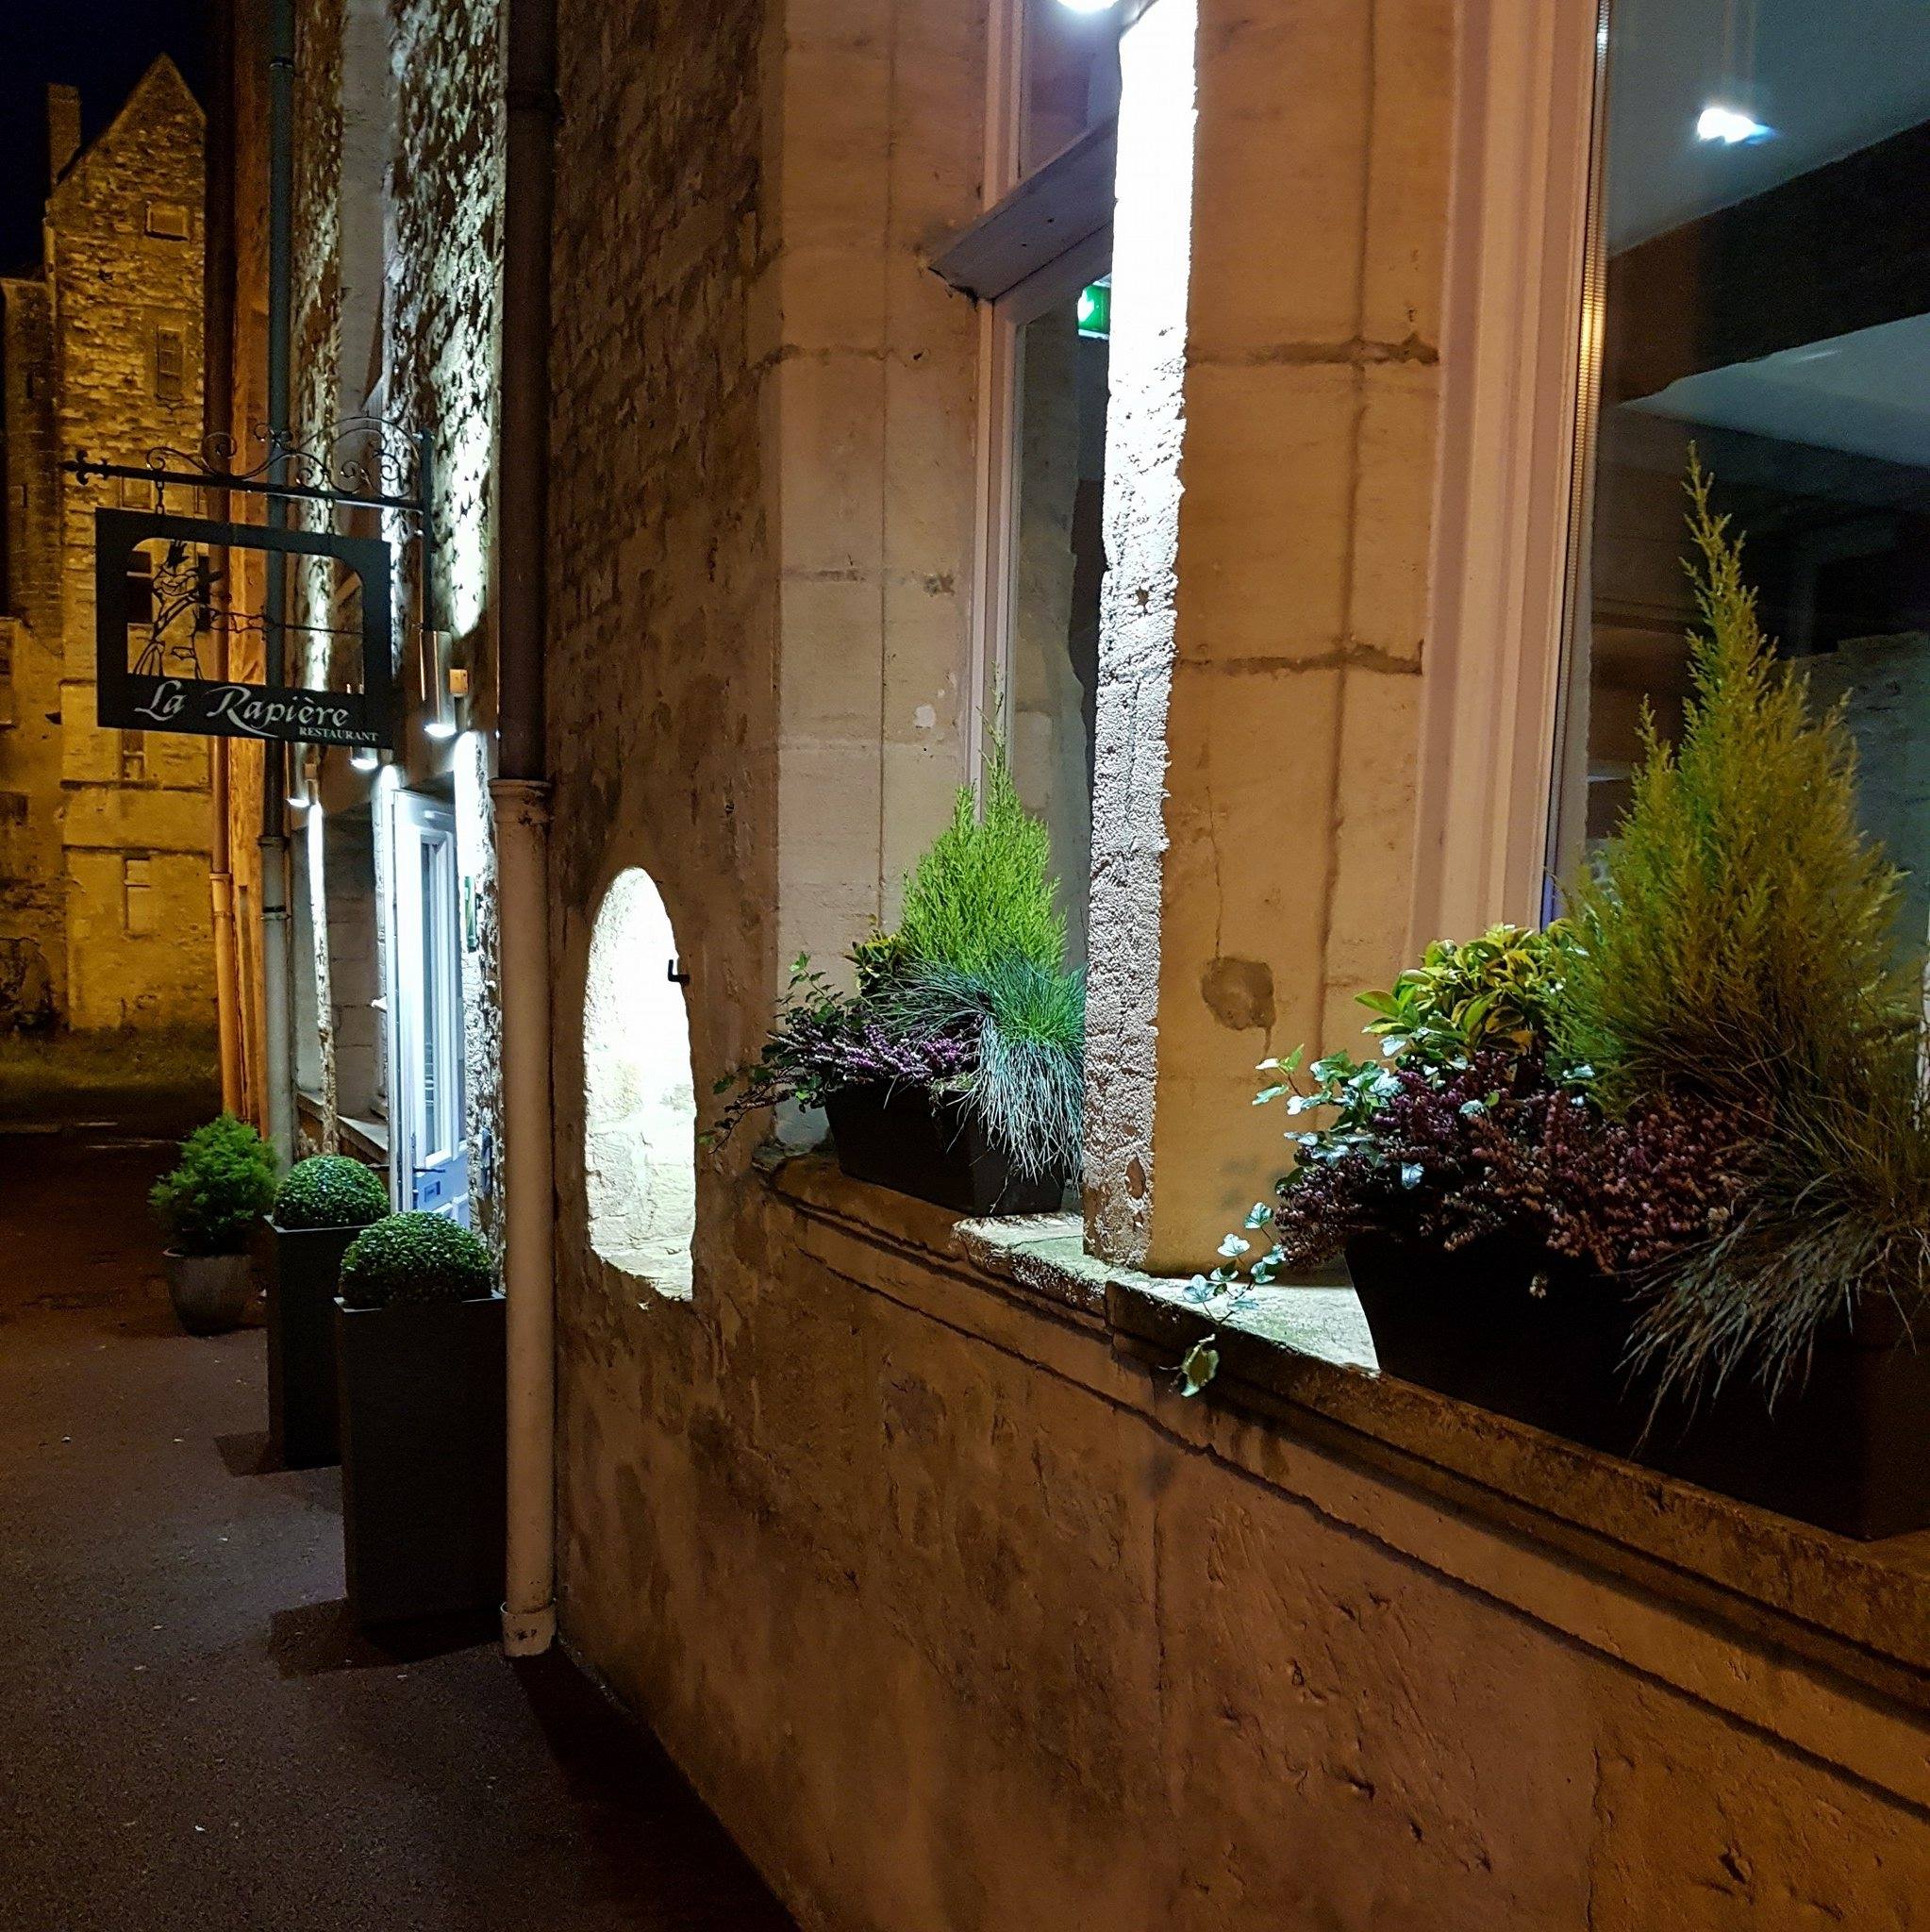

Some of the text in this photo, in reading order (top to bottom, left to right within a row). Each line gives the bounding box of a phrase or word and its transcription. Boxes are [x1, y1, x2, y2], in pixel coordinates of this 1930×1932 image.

[134, 679, 350, 738] La Rapière
[299, 726, 378, 742] RESTAURANT
